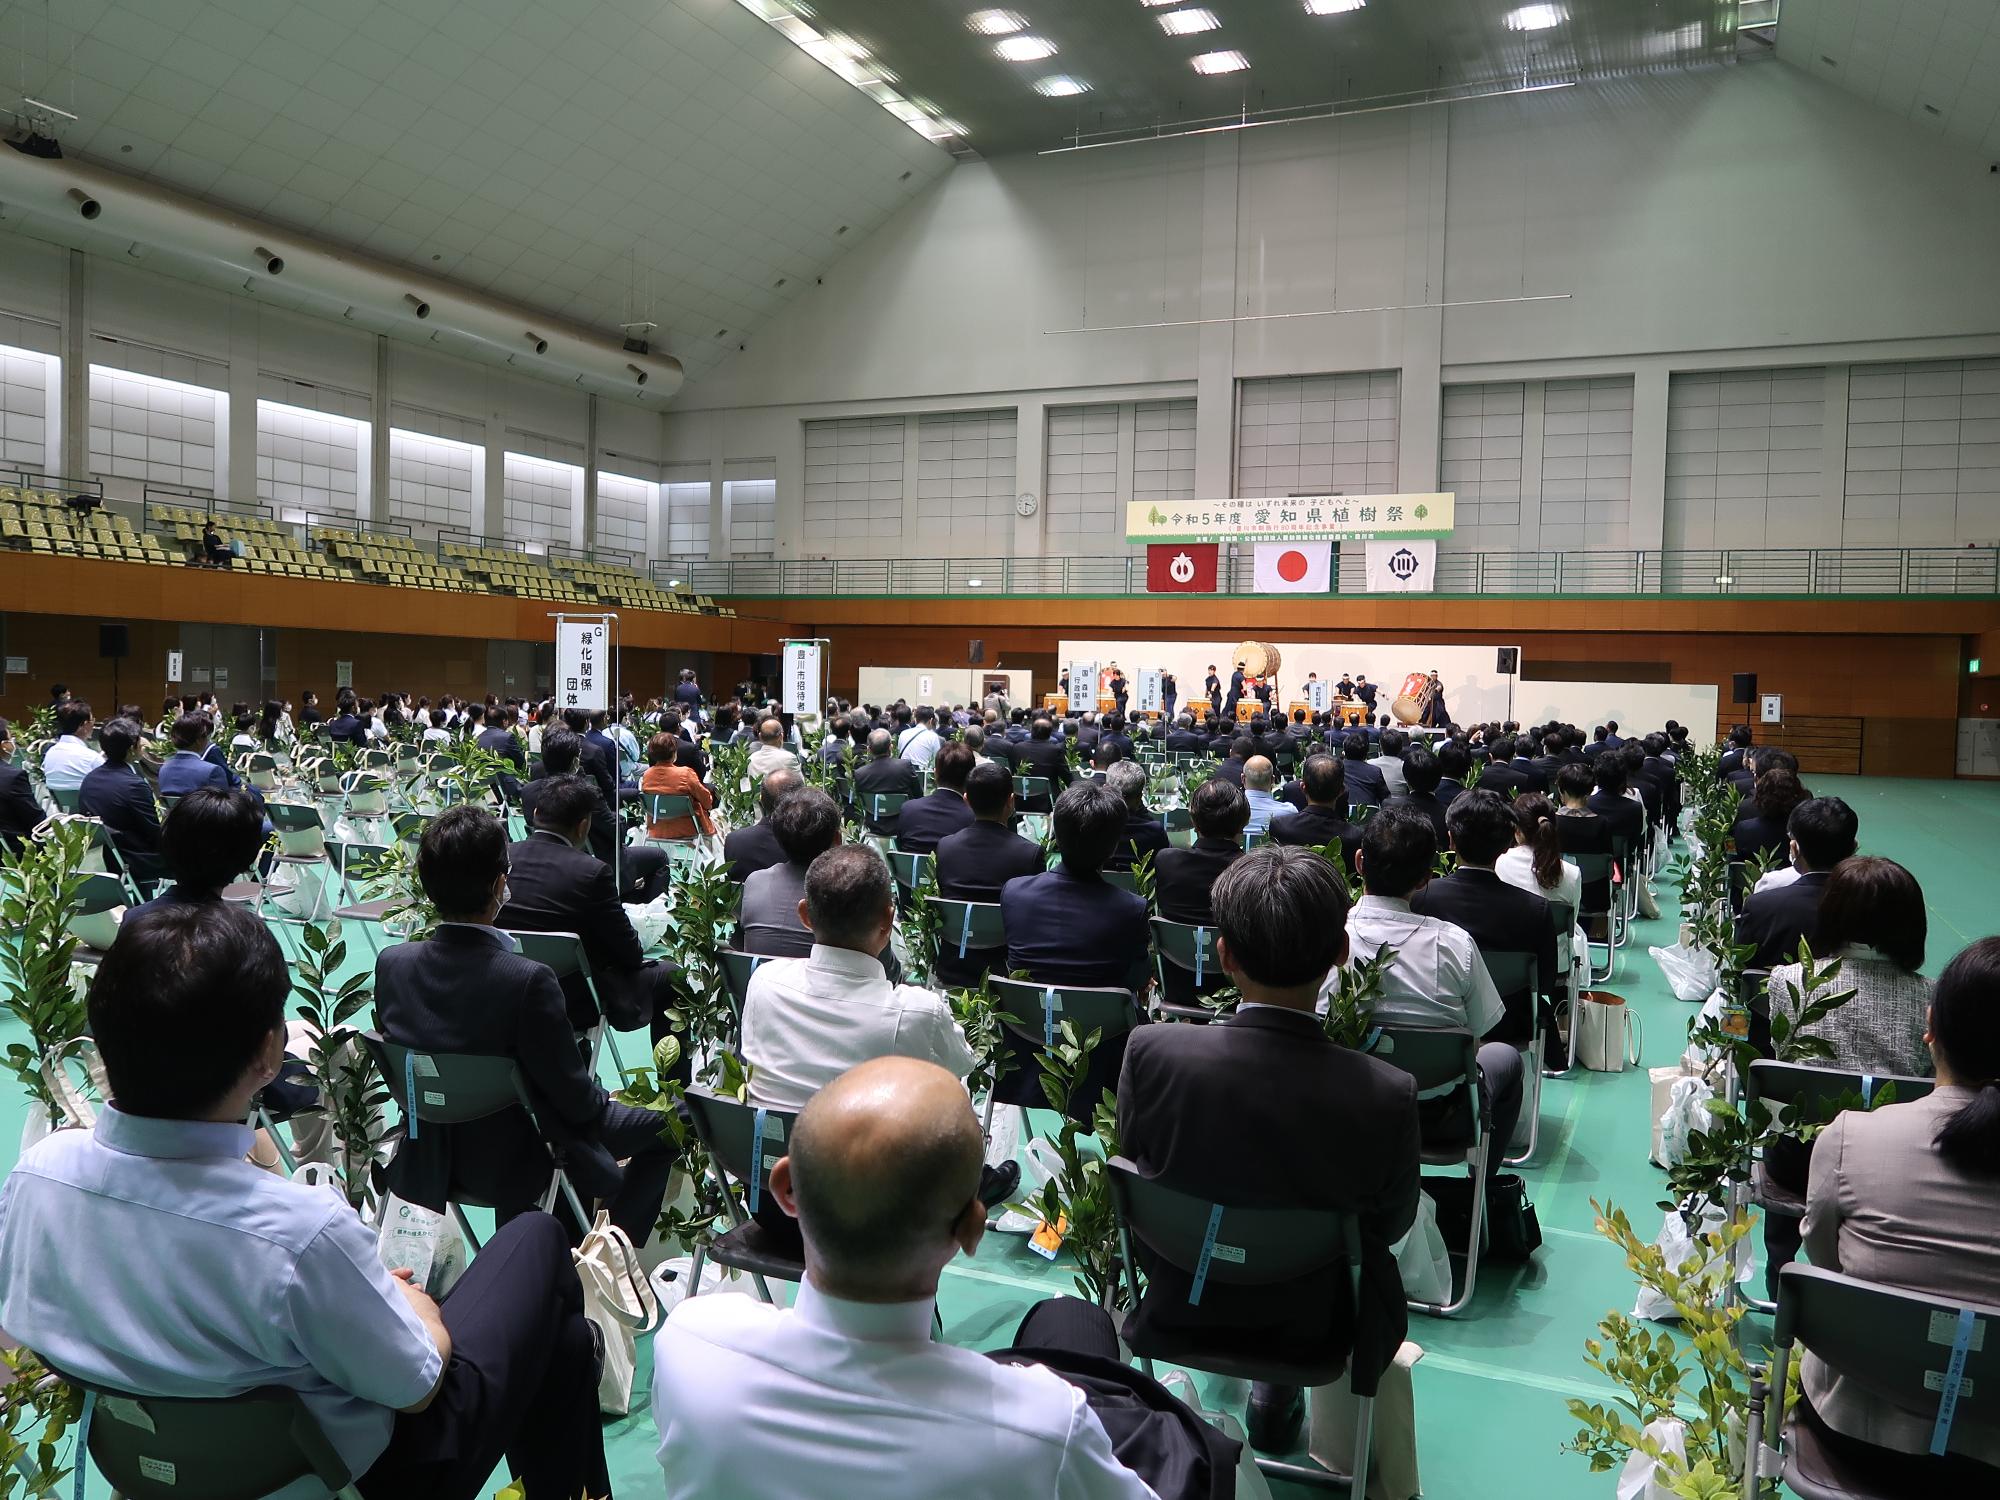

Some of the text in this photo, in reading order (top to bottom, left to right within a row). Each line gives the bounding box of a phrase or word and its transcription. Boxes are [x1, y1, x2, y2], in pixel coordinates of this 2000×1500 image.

[1170, 505, 1404, 526] 令和5年度 愛知県植樹祭
[594, 626, 602, 637] G
[581, 631, 593, 691] 緑化関係
[808, 648, 815, 656] J
[566, 677, 578, 706] 団体
[797, 649, 806, 712] 豊川市招待者
